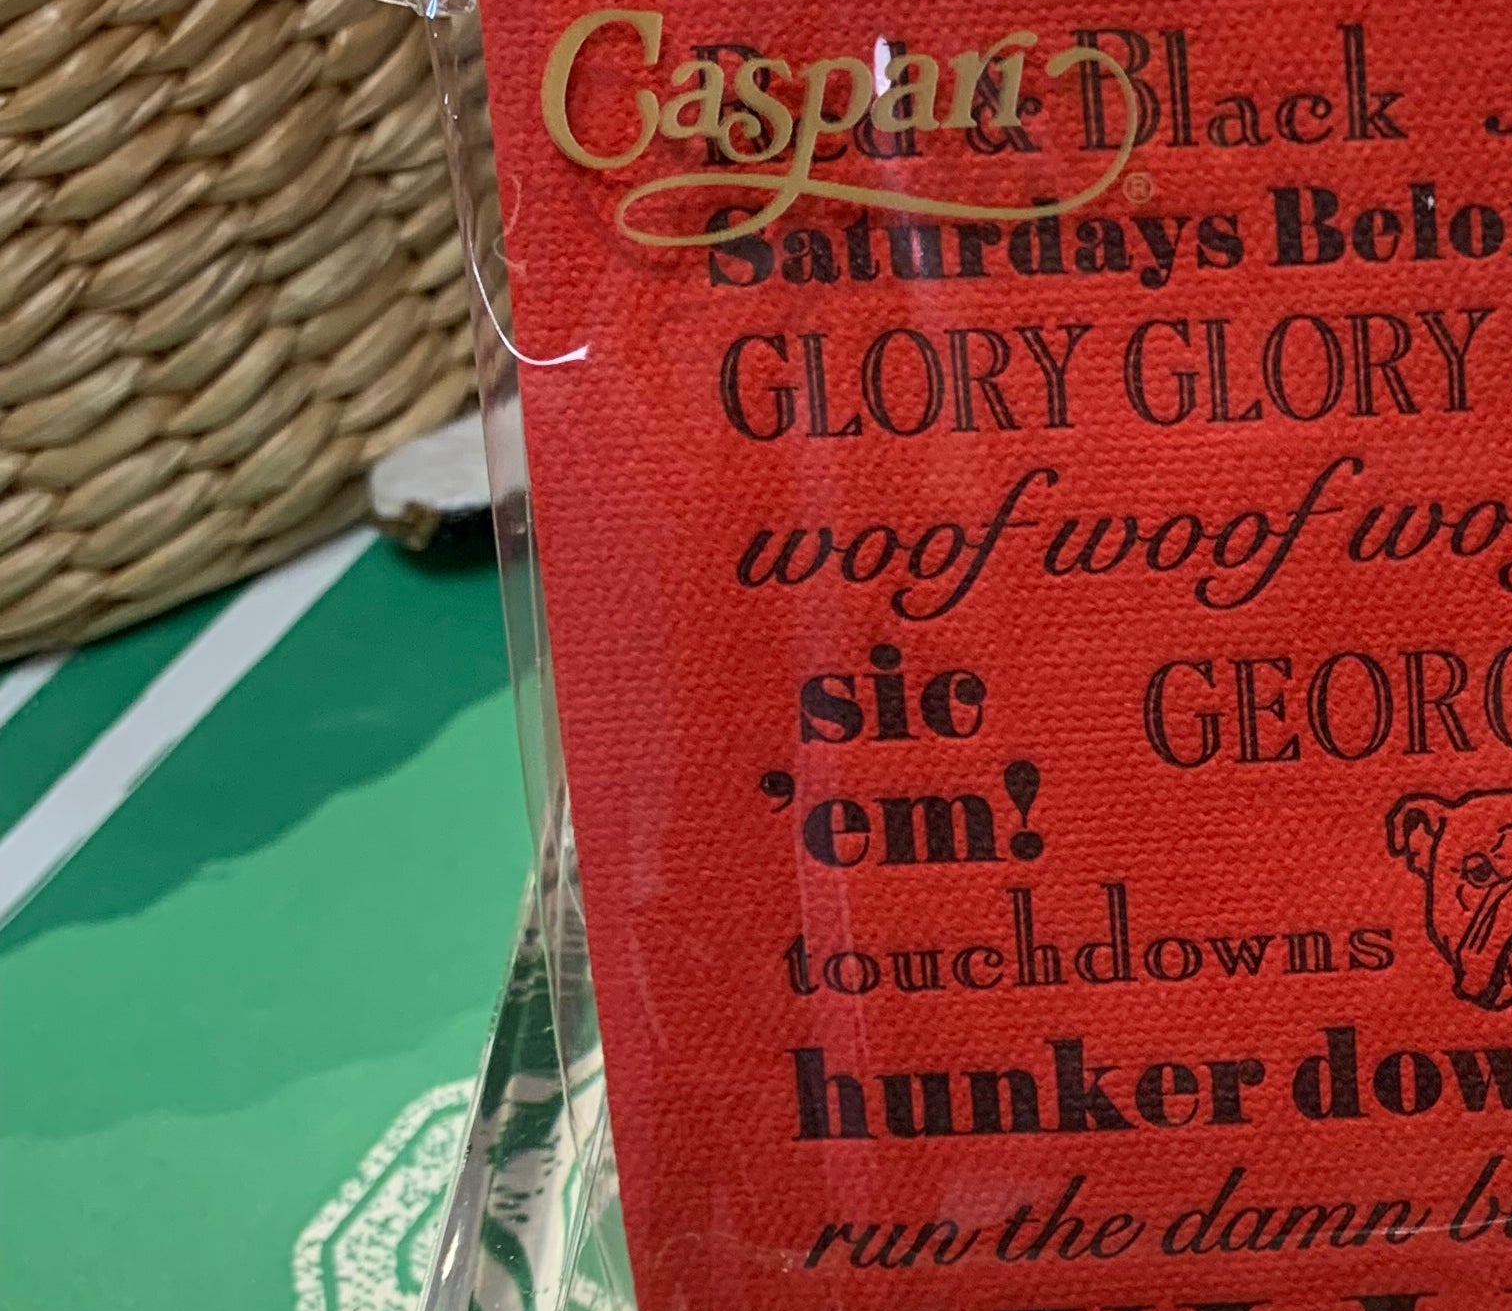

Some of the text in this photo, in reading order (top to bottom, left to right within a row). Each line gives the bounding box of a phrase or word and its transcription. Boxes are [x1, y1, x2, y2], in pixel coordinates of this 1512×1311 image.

[541, 9, 1138, 247] Caspari
[1070, 20, 1402, 154] Black
[706, 197, 1244, 290] Saturdays
[718, 323, 1090, 442] GLORY
[1122, 307, 1496, 426] GLORY
[736, 465, 1060, 622] woof
[1040, 455, 1366, 612] woof
[780, 882, 1396, 998] touchdowns
[784, 1038, 1268, 1144] hunker
[803, 1216, 982, 1272] run
[994, 1176, 1146, 1264] the
[1160, 1167, 1436, 1258] damn
